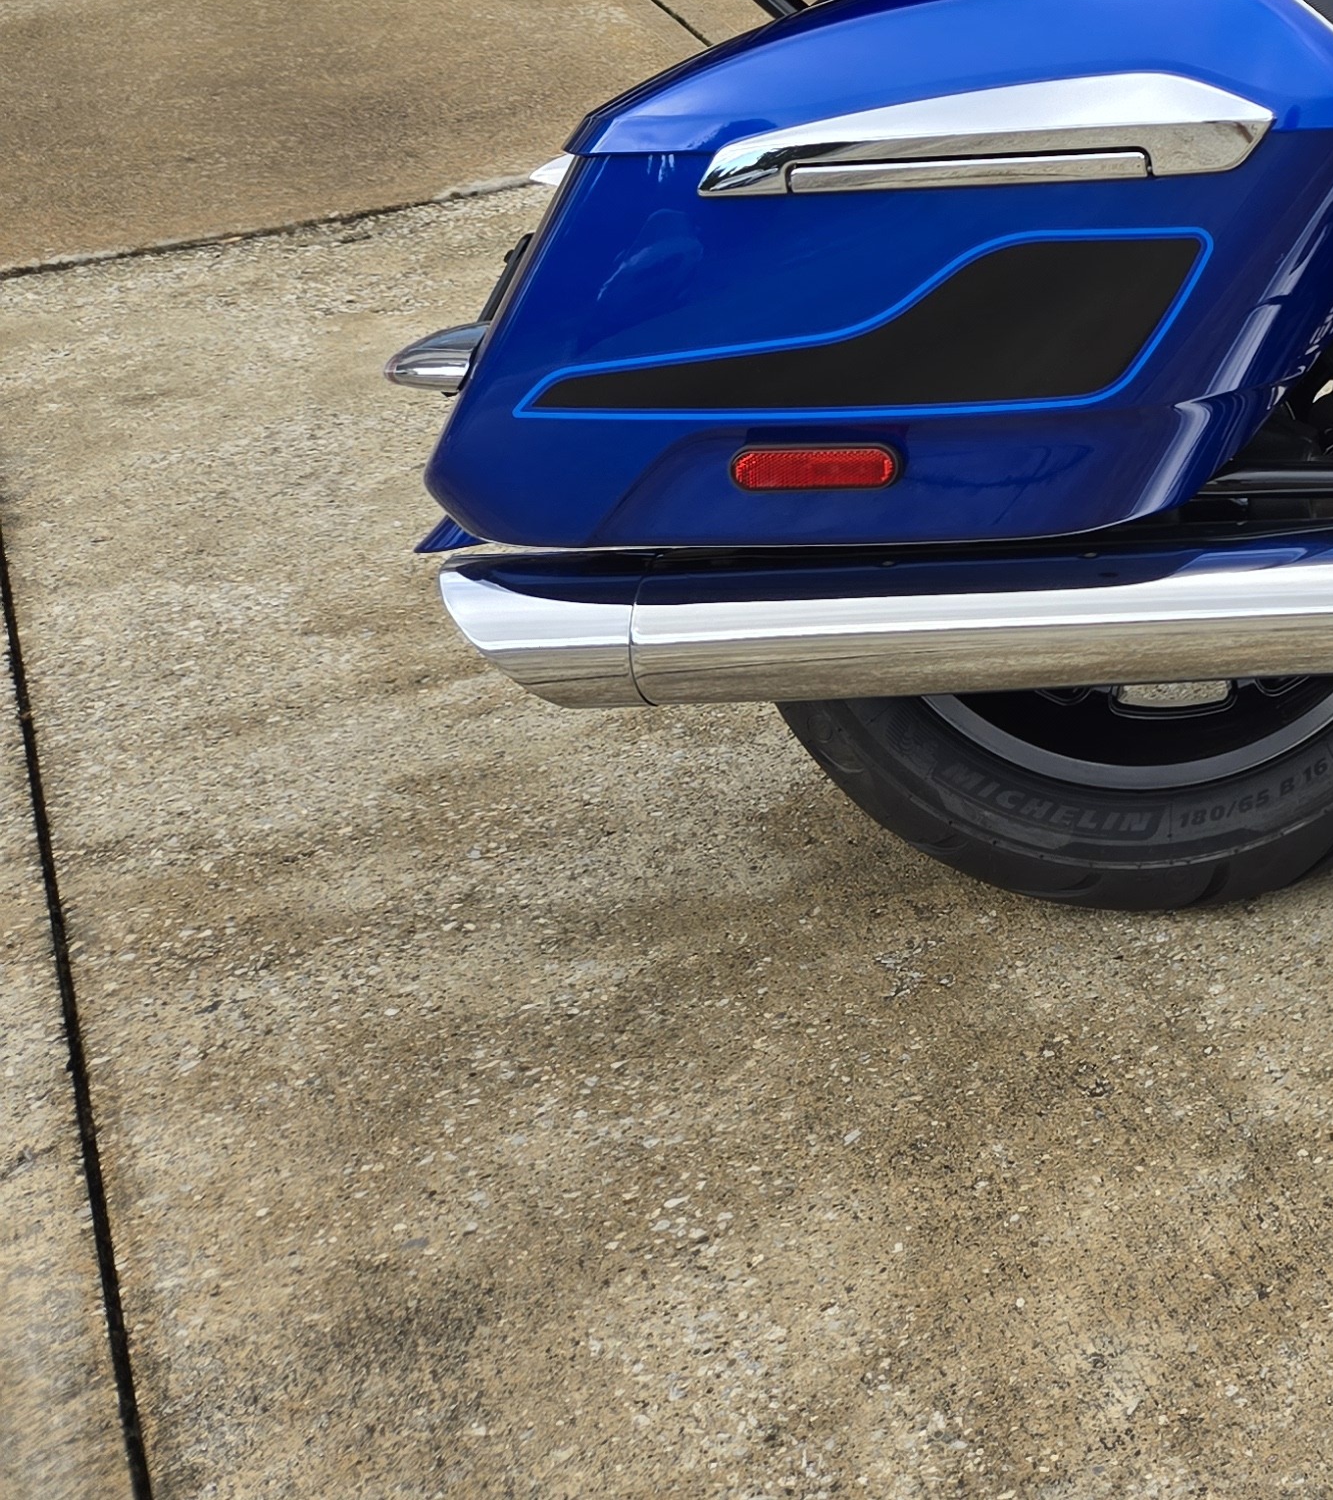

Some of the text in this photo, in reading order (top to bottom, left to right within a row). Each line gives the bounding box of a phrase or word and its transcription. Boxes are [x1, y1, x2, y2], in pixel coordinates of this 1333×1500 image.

[943, 758, 1328, 832] MICHELIN 180/65 B 16
